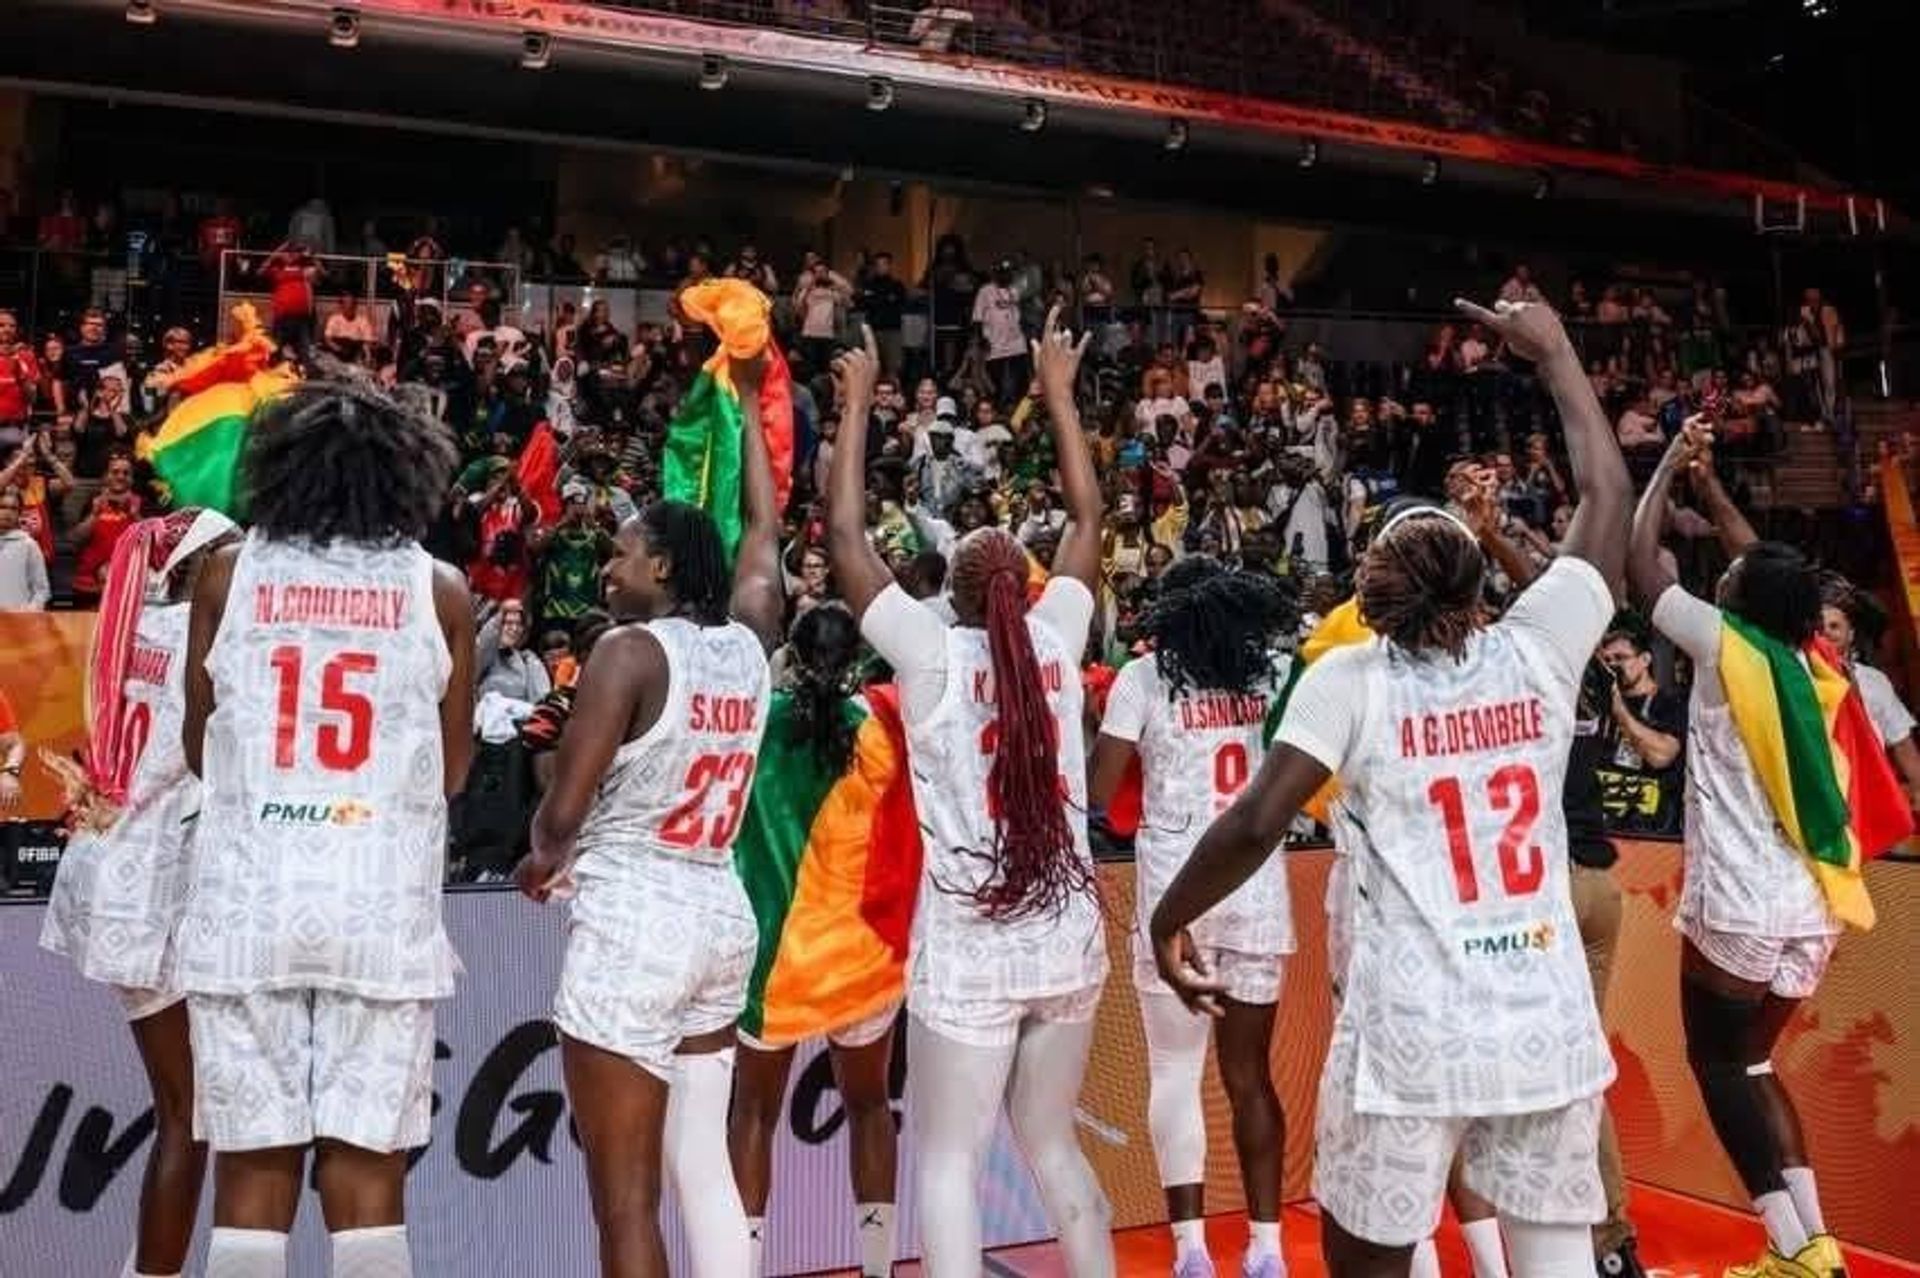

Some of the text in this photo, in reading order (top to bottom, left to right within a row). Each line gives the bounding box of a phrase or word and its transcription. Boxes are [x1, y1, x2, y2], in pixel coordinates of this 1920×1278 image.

[270, 644, 378, 773] 15
[1402, 698, 1543, 757] A G.DEMBELE
[260, 803, 332, 821] PMU
[655, 751, 755, 850] 23
[1427, 763, 1546, 905] 12
[1464, 931, 1530, 955] PMU
